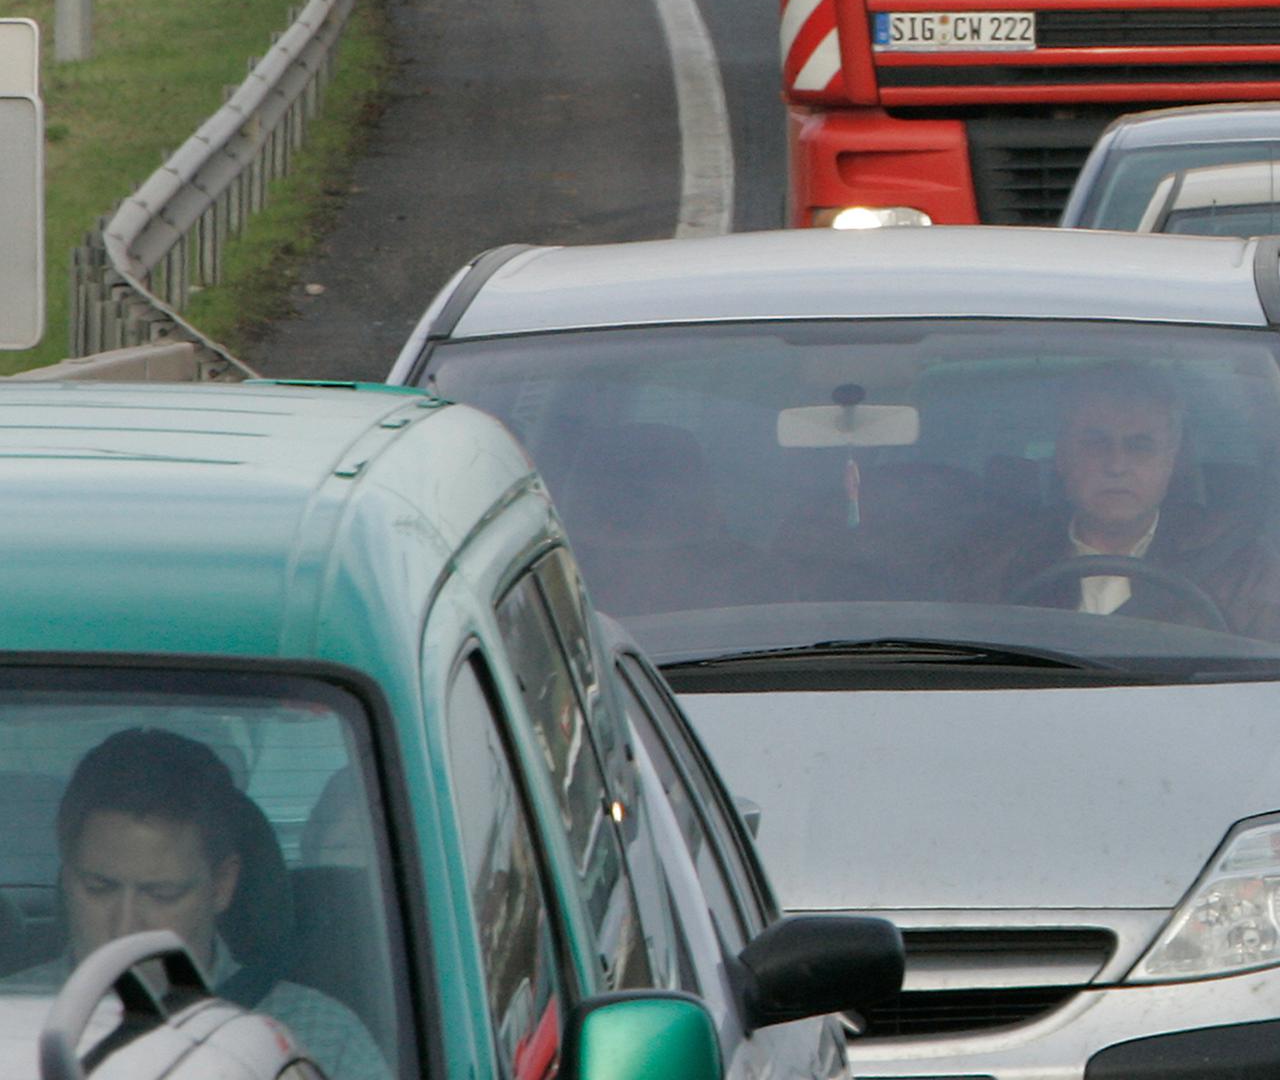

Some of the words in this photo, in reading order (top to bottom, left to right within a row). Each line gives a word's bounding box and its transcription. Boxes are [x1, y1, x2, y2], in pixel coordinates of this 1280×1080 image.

[892, 17, 935, 41] SIG
[953, 17, 982, 41] CW
[990, 17, 1033, 41] 222
